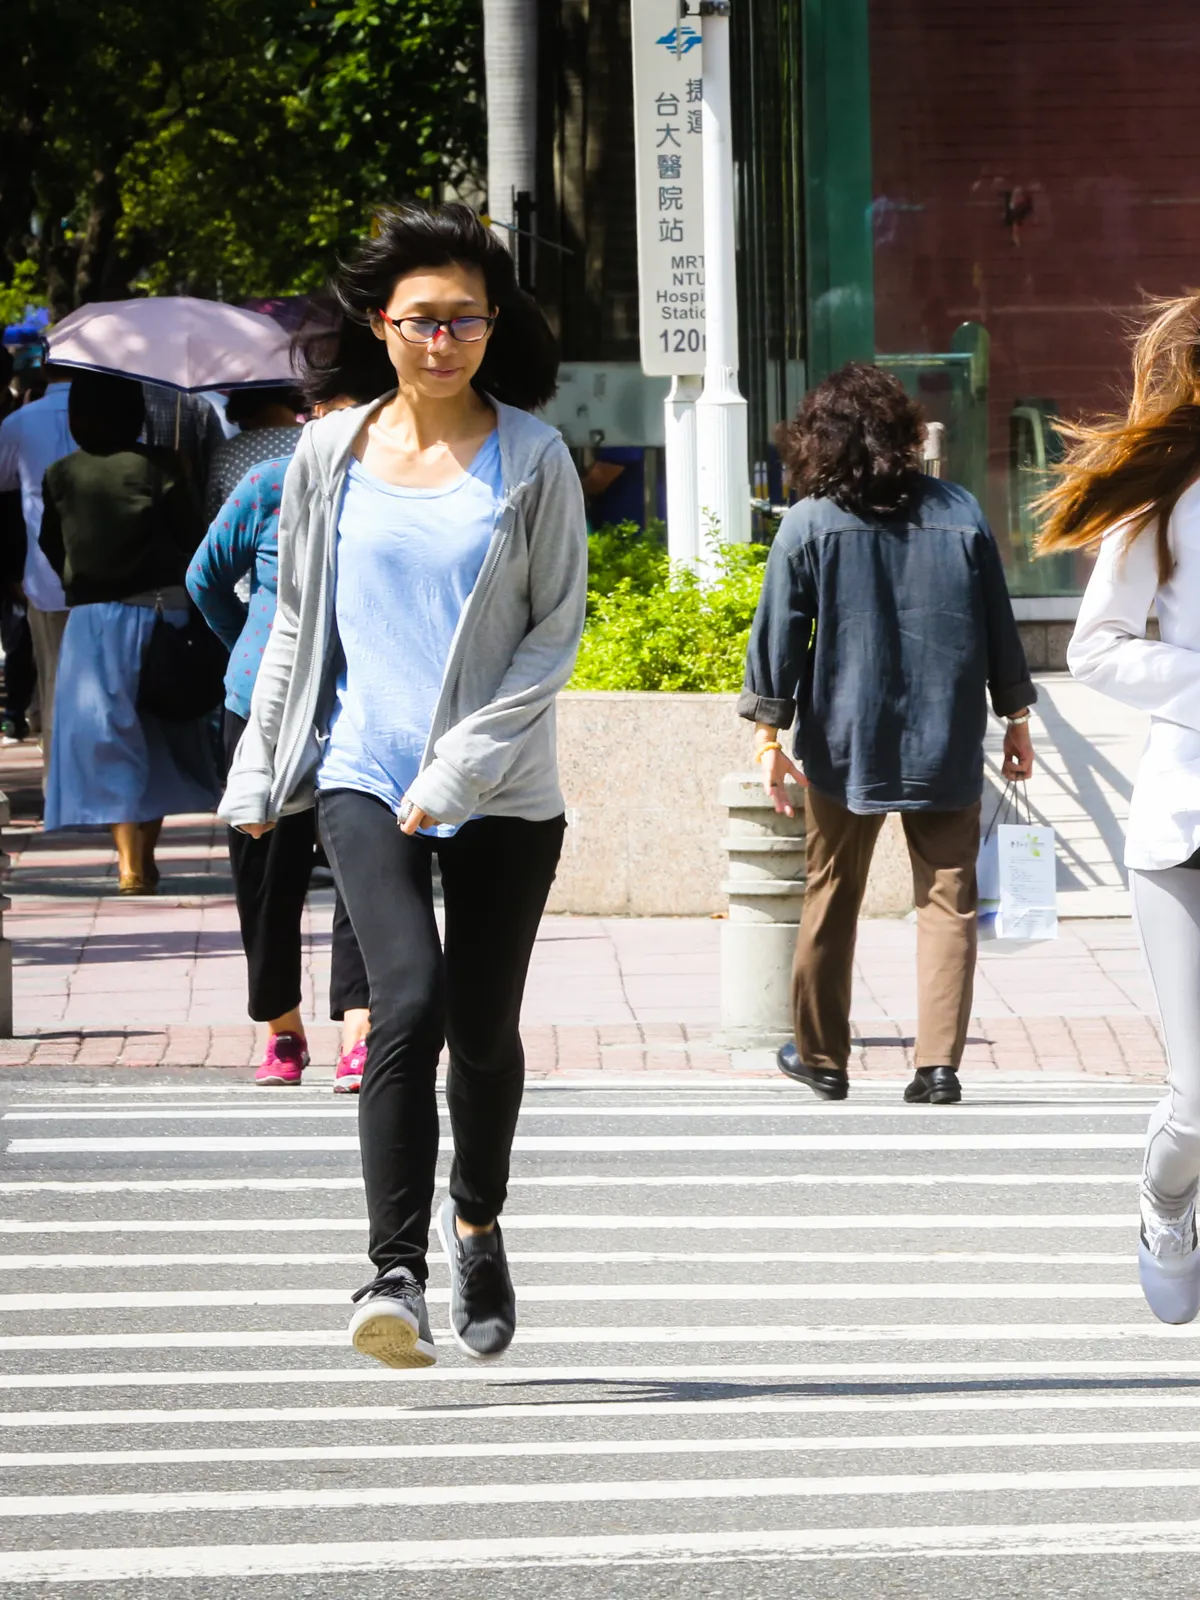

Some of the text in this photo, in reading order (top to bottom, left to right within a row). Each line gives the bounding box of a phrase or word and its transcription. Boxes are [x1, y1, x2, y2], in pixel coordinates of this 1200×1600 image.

[655, 92, 684, 242] 台大醫院站
[673, 272, 705, 286] NTU
[656, 289, 704, 306] Hospi
